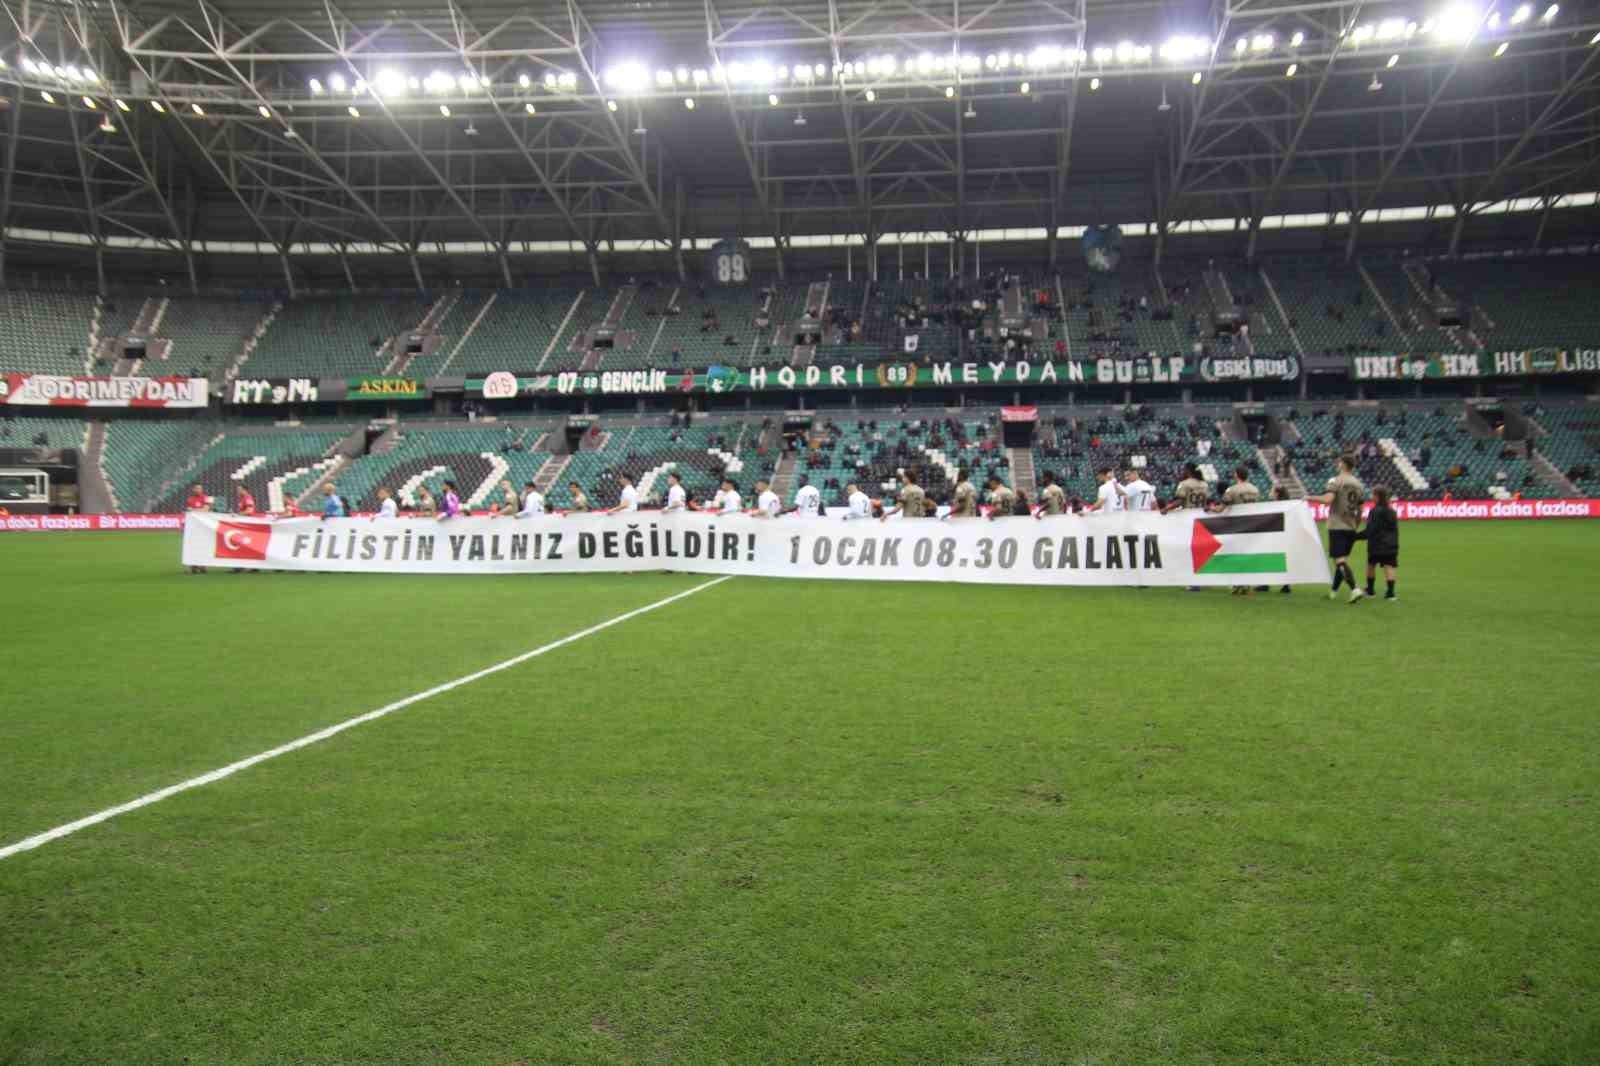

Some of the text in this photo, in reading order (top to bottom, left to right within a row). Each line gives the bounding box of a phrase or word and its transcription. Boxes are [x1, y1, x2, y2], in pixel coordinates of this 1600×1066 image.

[717, 254, 744, 282] 89
[887, 367, 907, 381] 89
[557, 372, 577, 394] 07
[1407, 503, 1488, 518] bankadan
[1491, 502, 1532, 517] daha
[8, 514, 38, 529] daha
[119, 515, 179, 529] bankadan
[292, 523, 1163, 569] FİLİSTİN YALNIZ DEĞİLDİR! 1 OCAK 08.30 GALATA
